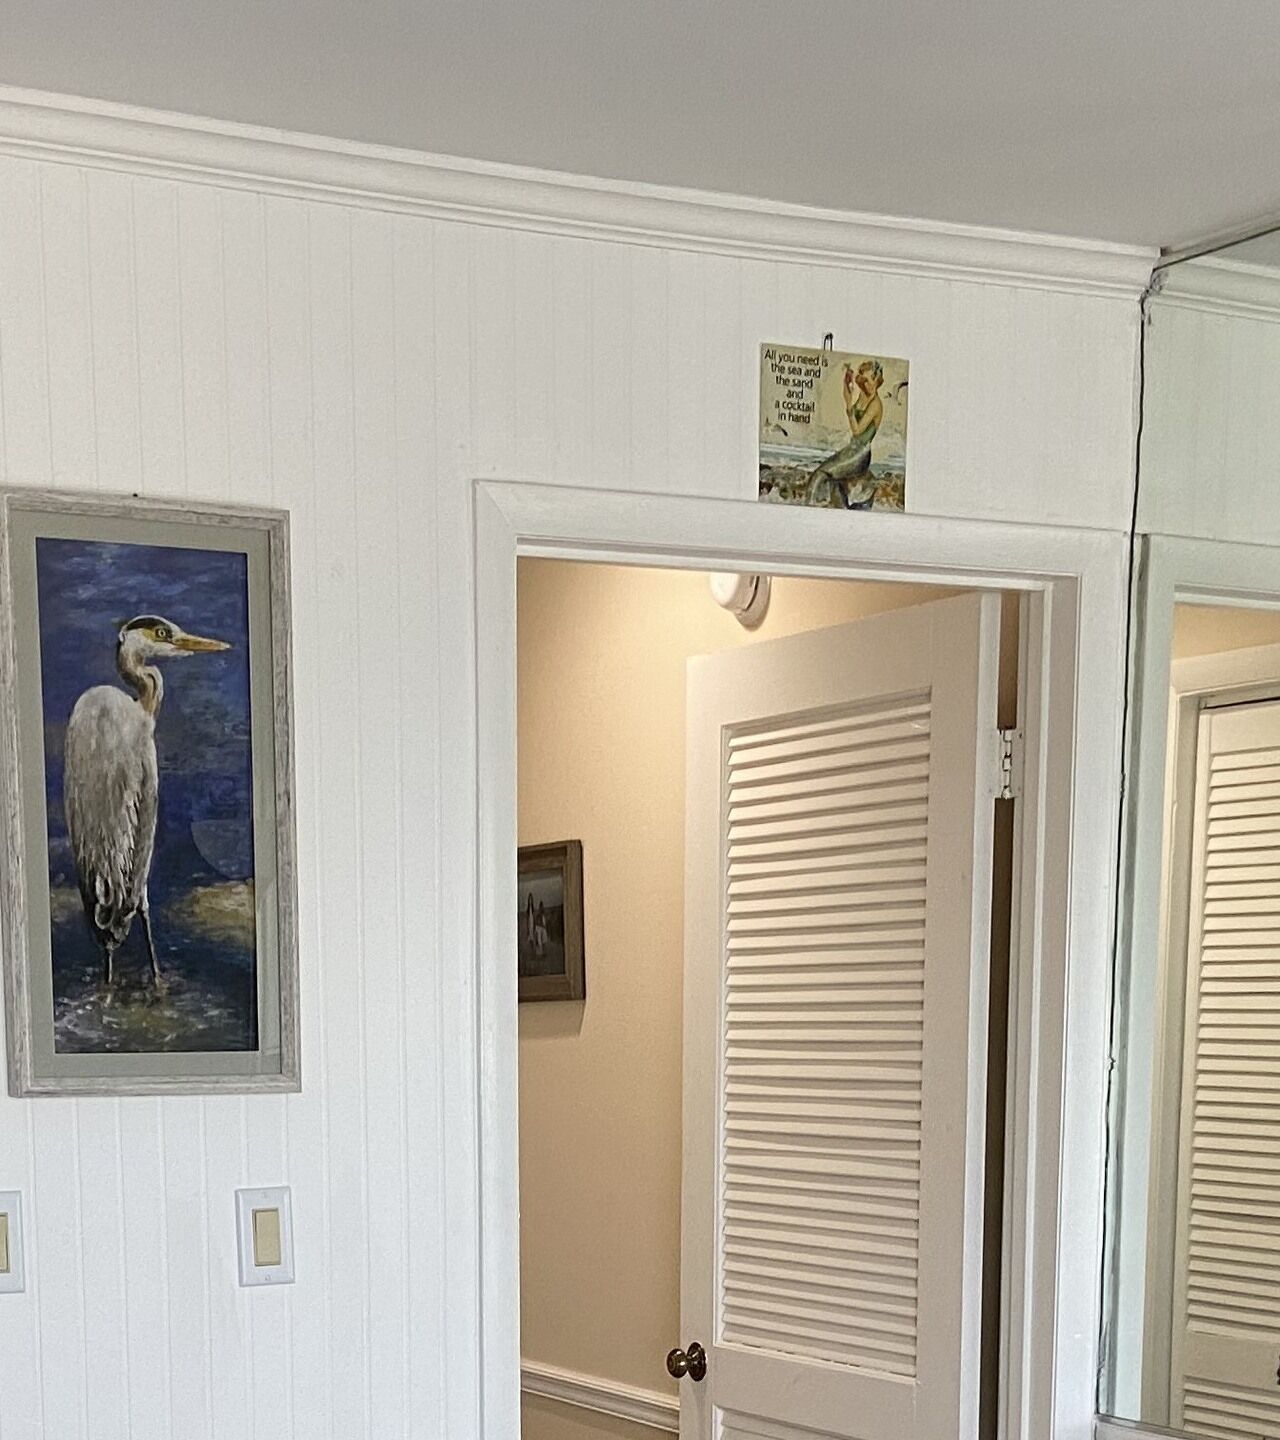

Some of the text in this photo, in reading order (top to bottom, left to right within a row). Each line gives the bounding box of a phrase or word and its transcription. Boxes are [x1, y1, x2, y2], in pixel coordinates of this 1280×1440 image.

[764, 349, 829, 367] All you need is
[771, 362, 821, 378] the sea and
[776, 375, 813, 389] the sand
[786, 388, 804, 399] and
[774, 401, 815, 412] a cocktail
[778, 411, 811, 424] in hand
